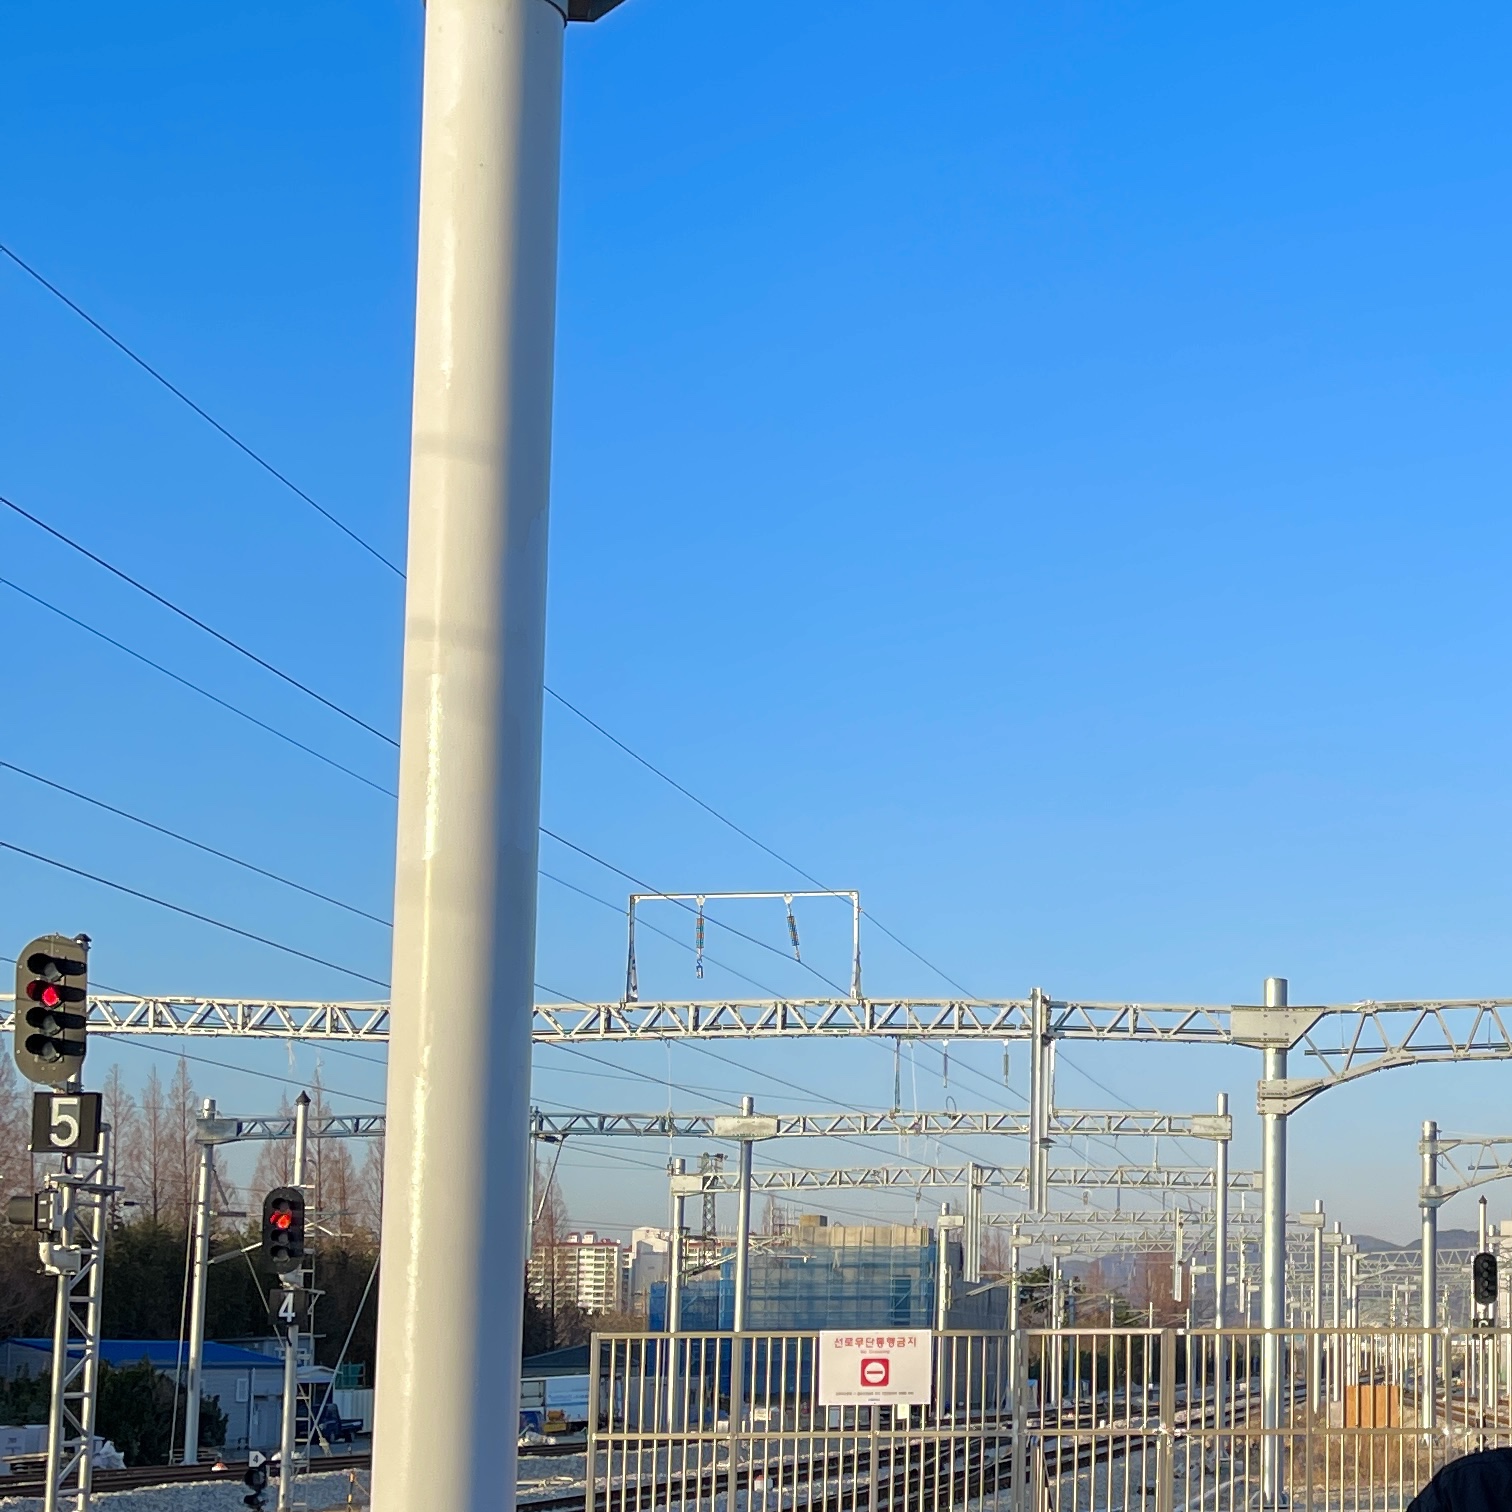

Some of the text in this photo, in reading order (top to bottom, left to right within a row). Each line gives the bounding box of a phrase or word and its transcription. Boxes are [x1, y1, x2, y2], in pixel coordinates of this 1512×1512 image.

[49, 1096, 79, 1147] 5
[278, 1292, 296, 1323] 4
[834, 1337, 917, 1348] 선로무단통행금지
[253, 1454, 259, 1464] 4
